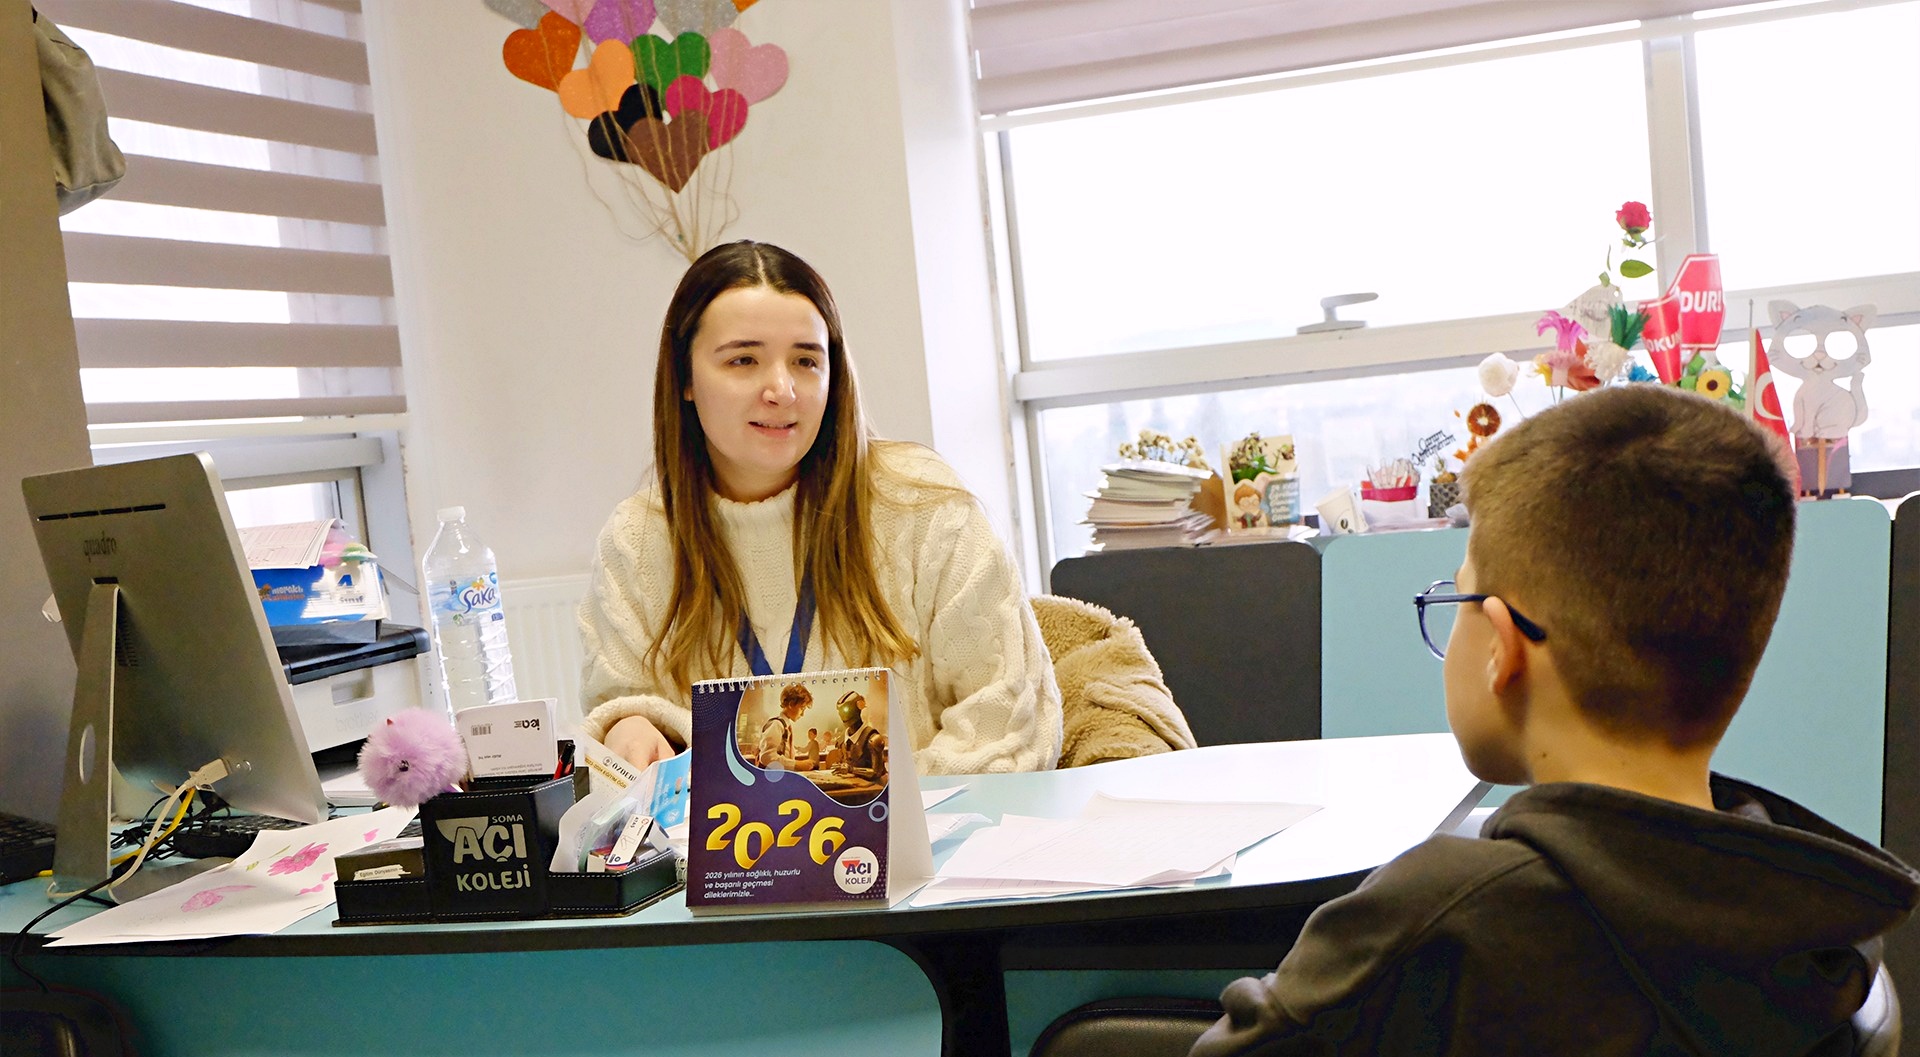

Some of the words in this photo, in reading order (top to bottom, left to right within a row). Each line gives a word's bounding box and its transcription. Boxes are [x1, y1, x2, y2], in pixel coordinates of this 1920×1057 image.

[1680, 290, 1721, 313] DUR!
[83, 530, 117, 563] quadro
[463, 587, 496, 614] Saka
[491, 814, 524, 824] SOMA
[453, 823, 527, 864] AÇI
[705, 799, 846, 870] 2026
[456, 863, 531, 892] KOLEJİ
[704, 872, 723, 880] 2026
[723, 871, 745, 880] yılının
[745, 869, 773, 879] sağlıklı,
[773, 868, 801, 877] huzurlu
[714, 880, 741, 890] başarılı
[742, 879, 774, 889] geçmesi
